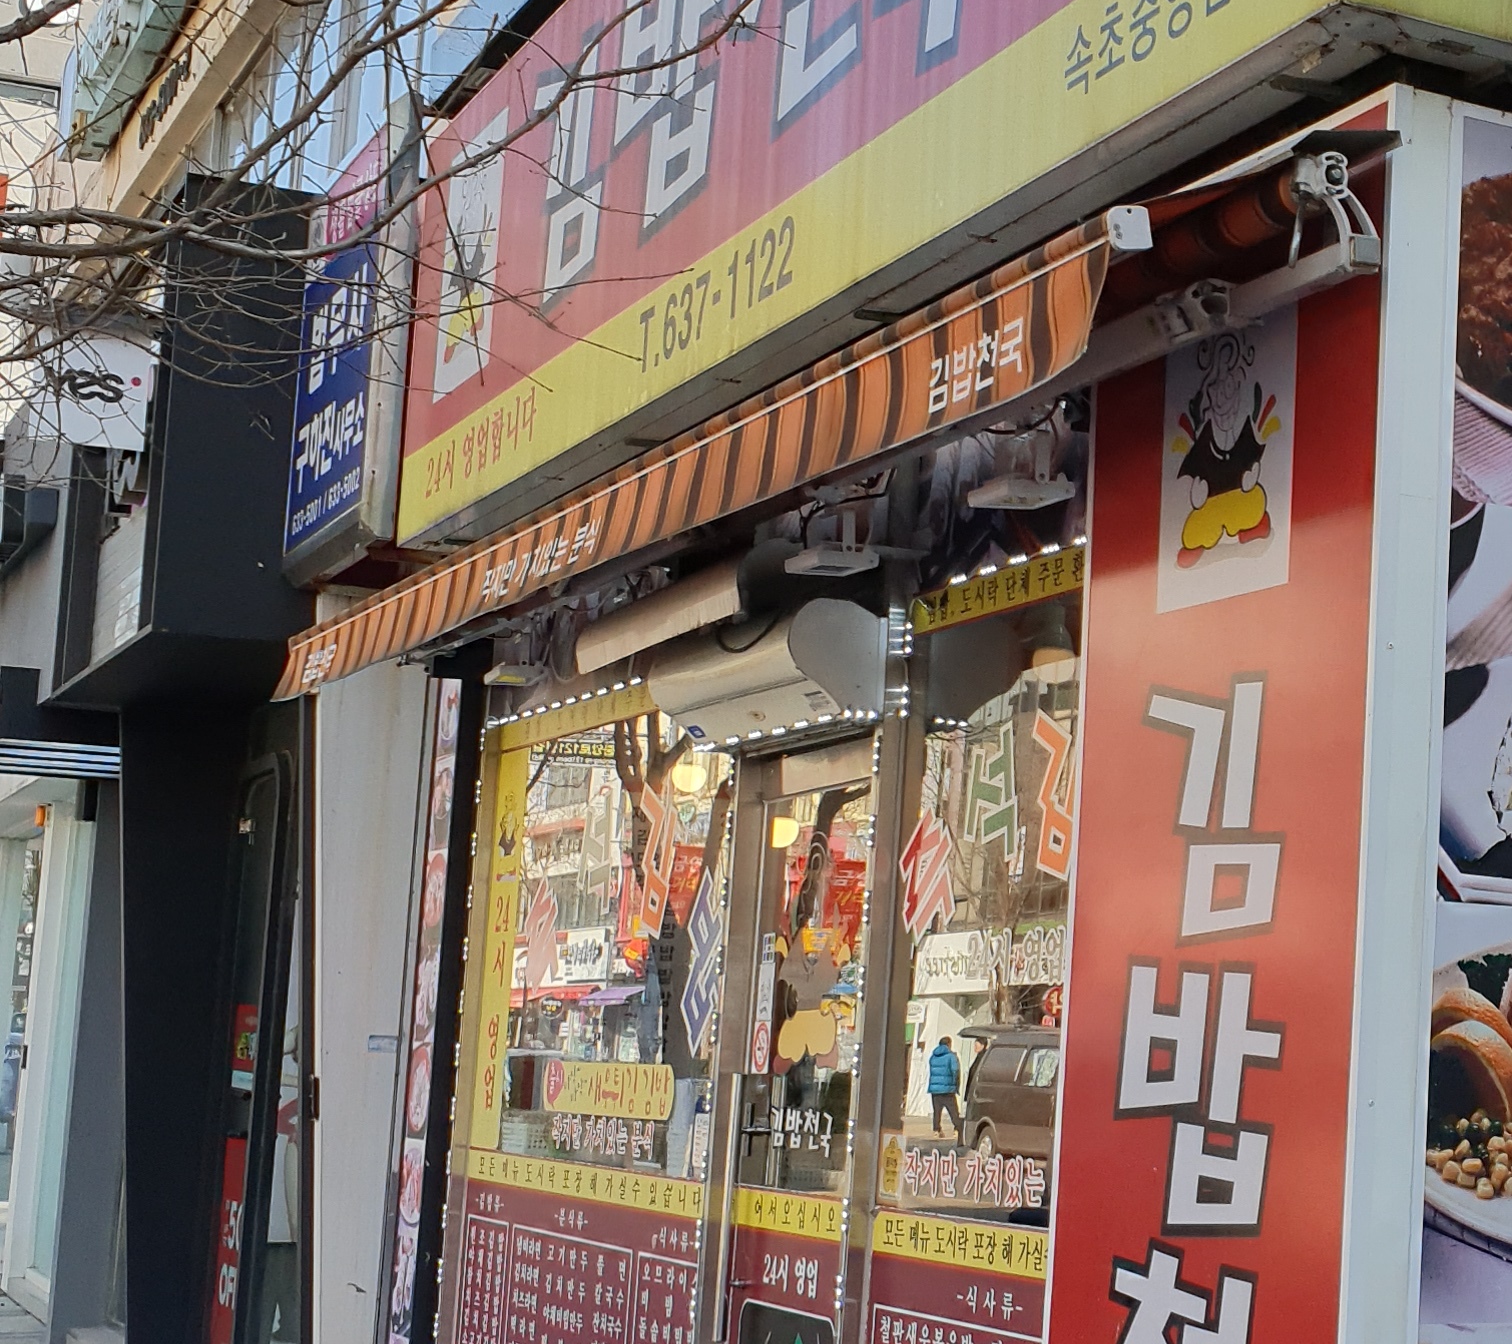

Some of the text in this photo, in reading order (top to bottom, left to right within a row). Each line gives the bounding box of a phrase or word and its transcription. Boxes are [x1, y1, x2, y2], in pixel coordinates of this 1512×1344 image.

[639, 215, 795, 374] T.637-1122
[928, 316, 1023, 413] 김밥천국
[425, 386, 537, 499] 24시 영업합니다
[960, 577, 999, 613] 도시락
[1038, 558, 1065, 592] 주문
[483, 1013, 500, 1111] 영업
[771, 1105, 834, 1160] 김밥천국
[478, 1156, 496, 1175] 모든
[525, 1161, 556, 1189] 도시락
[649, 1182, 702, 1213] 있습니다
[903, 1147, 959, 1199] 작지만
[964, 1152, 1047, 1209] 가치있는
[754, 1195, 838, 1233] 어서오십시오
[883, 1219, 904, 1248] 모든
[909, 1221, 931, 1255] 메뉴
[934, 1226, 969, 1261] 도시락
[973, 1233, 997, 1265] 포장
[763, 1252, 819, 1300] 24시 영업
